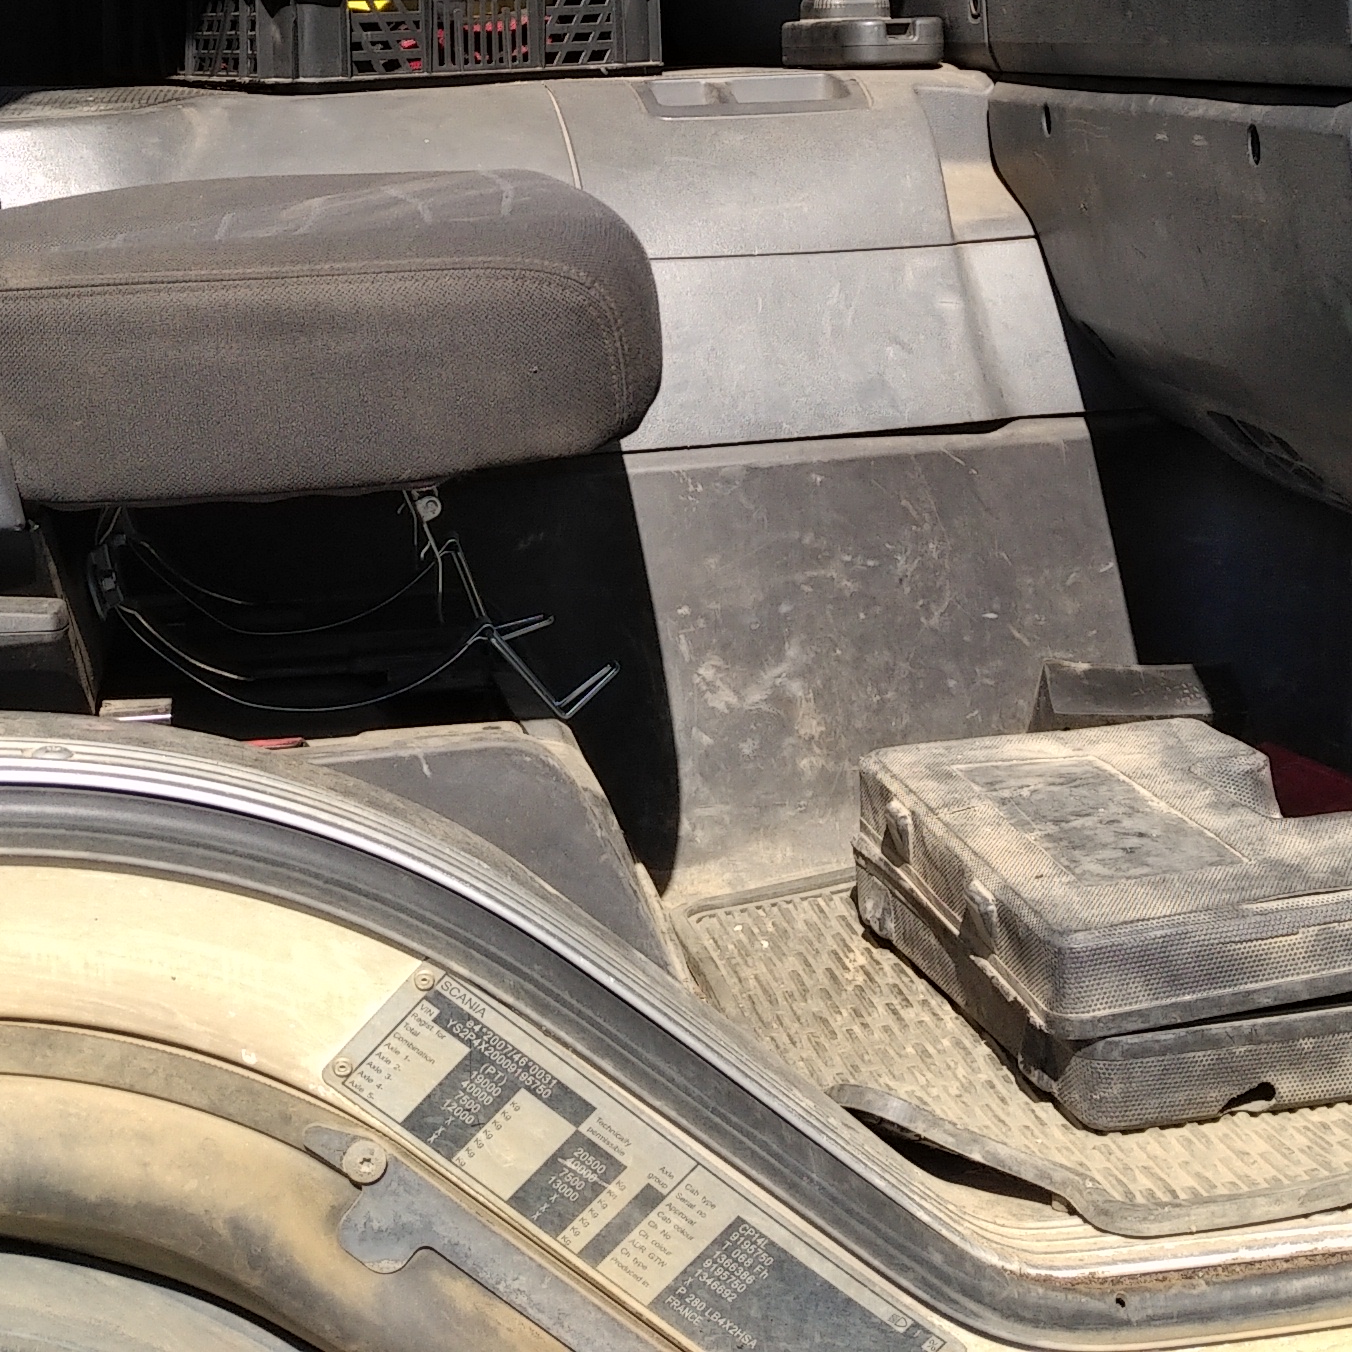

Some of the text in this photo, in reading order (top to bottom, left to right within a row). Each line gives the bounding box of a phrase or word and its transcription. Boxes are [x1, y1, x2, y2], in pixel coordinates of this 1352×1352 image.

[420, 1003, 435, 1017] VIN
[440, 980, 486, 1019] SCANIA
[403, 1021, 421, 1038] Total
[435, 1029, 447, 1040] for
[374, 1051, 392, 1065] Axle
[383, 1042, 401, 1056] Axle
[392, 1031, 436, 1065] Combination
[446, 1018, 552, 1099] YS2P4X20009195750
[357, 1070, 374, 1084] Axle
[365, 1061, 383, 1074] Axle
[479, 1062, 508, 1087] (PT)
[348, 1079, 365, 1093] Axle
[460, 1079, 494, 1106] 40000
[470, 1070, 502, 1097] 19000
[442, 1098, 475, 1125] 12000
[453, 1089, 481, 1114] 7500
[509, 1101, 521, 1112] Kg
[500, 1110, 512, 1122] Kg
[586, 1126, 626, 1157] permissible
[596, 1116, 632, 1147] Technically
[573, 1147, 607, 1175] 20500
[659, 1166, 675, 1180] Axle
[548, 1175, 580, 1202] 13000
[558, 1167, 586, 1191] 7500
[615, 1179, 627, 1192] Kg
[646, 1172, 668, 1189] group
[596, 1198, 609, 1210] Kg
[675, 1192, 707, 1218] Serial no
[684, 1183, 717, 1210] Cab type
[578, 1216, 590, 1228] Kg
[587, 1207, 599, 1219] Kg
[665, 1202, 697, 1227] Approval
[569, 1225, 581, 1237] Kg
[656, 1211, 695, 1241] Cab colour
[659, 1229, 672, 1240] No
[738, 1223, 769, 1250] CP14L
[560, 1234, 572, 1246] Kg
[650, 1239, 673, 1256] colour
[729, 1231, 774, 1266] 9195750
[628, 1239, 667, 1268] ADR GTW
[632, 1257, 648, 1271] type
[721, 1240, 769, 1280] T 068 Fh
[610, 1256, 644, 1283] Produced
[702, 1258, 747, 1293] 9195750
[712, 1250, 756, 1285] 1366386
[694, 1268, 738, 1303] 1346692
[664, 1295, 704, 1327] FRANCE
[675, 1284, 758, 1350] P 280 LB4X2HSA
